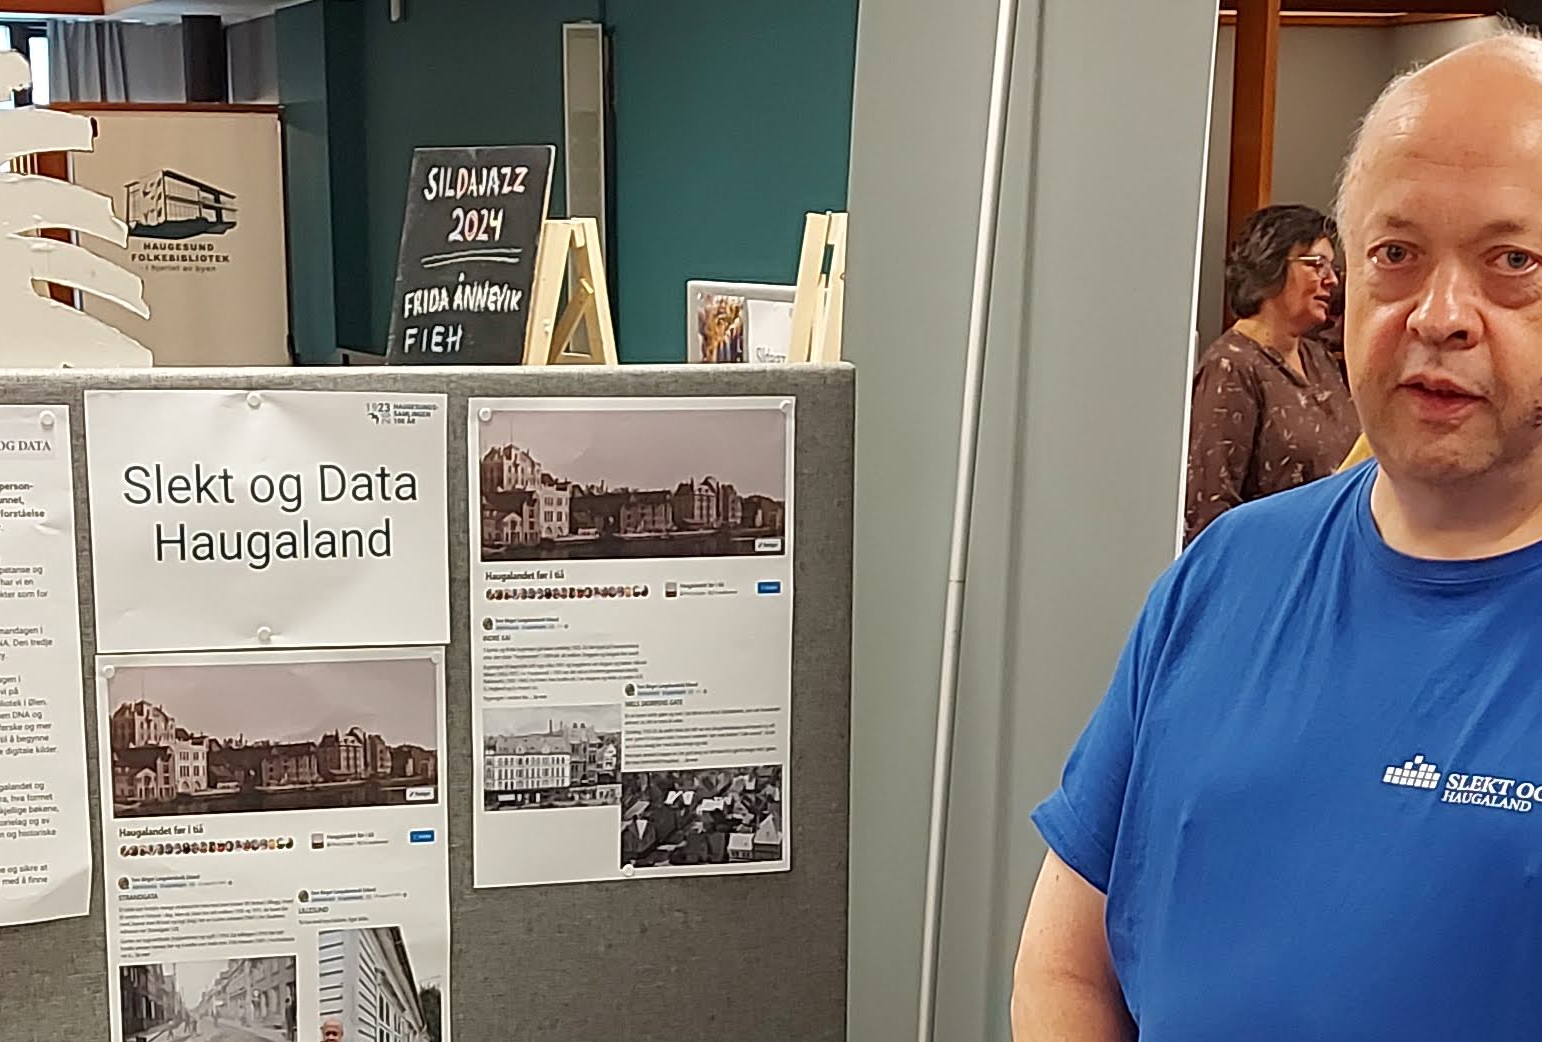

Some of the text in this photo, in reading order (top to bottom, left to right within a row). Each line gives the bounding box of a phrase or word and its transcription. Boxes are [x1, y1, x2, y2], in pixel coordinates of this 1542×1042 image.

[423, 166, 528, 200] SILDAJAZZ
[448, 207, 504, 241] 2024
[131, 253, 229, 262] FOLKEBIBLIOTEK
[143, 243, 214, 251] HAUGESUND
[403, 286, 449, 318] FRIDA
[404, 324, 463, 353] FIEH
[18, 440, 51, 451] DATA
[123, 463, 418, 512] Slekt og Data
[156, 517, 393, 569] Haugaland
[485, 570, 535, 581] Haugalandet
[1445, 772, 1515, 796] SLEKT
[1440, 789, 1533, 813] HAUGALAND
[118, 826, 172, 839] Haugalandet
